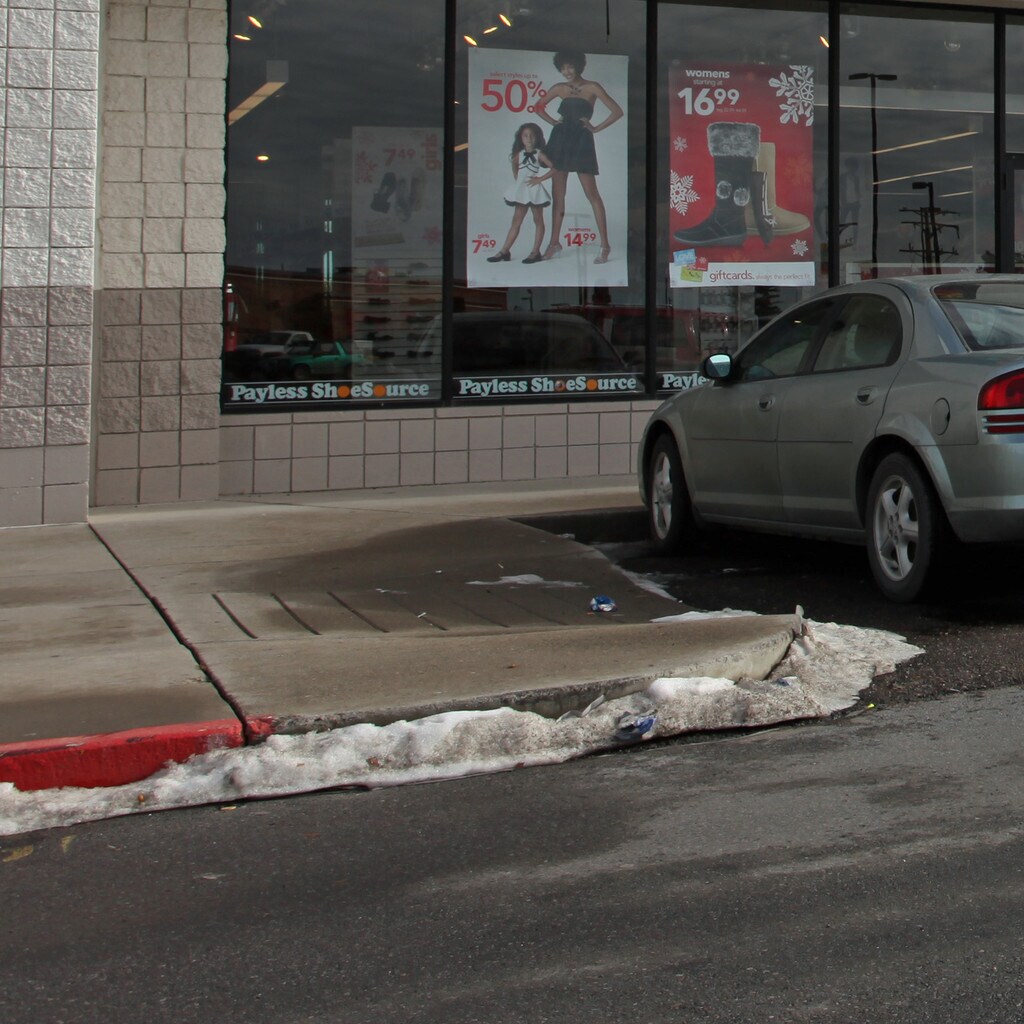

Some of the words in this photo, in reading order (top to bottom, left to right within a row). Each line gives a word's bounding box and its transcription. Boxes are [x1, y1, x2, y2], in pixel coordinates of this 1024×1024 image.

[685, 69, 730, 79] womens
[693, 79, 716, 87] starting
[481, 79, 547, 113] 50%
[709, 270, 755, 283] giftcards.
[459, 378, 528, 397] Payless
[531, 375, 636, 393] ShoeSource
[662, 373, 710, 390] Payle
[231, 384, 308, 403] Payless
[312, 381, 429, 398] ShoeSource
